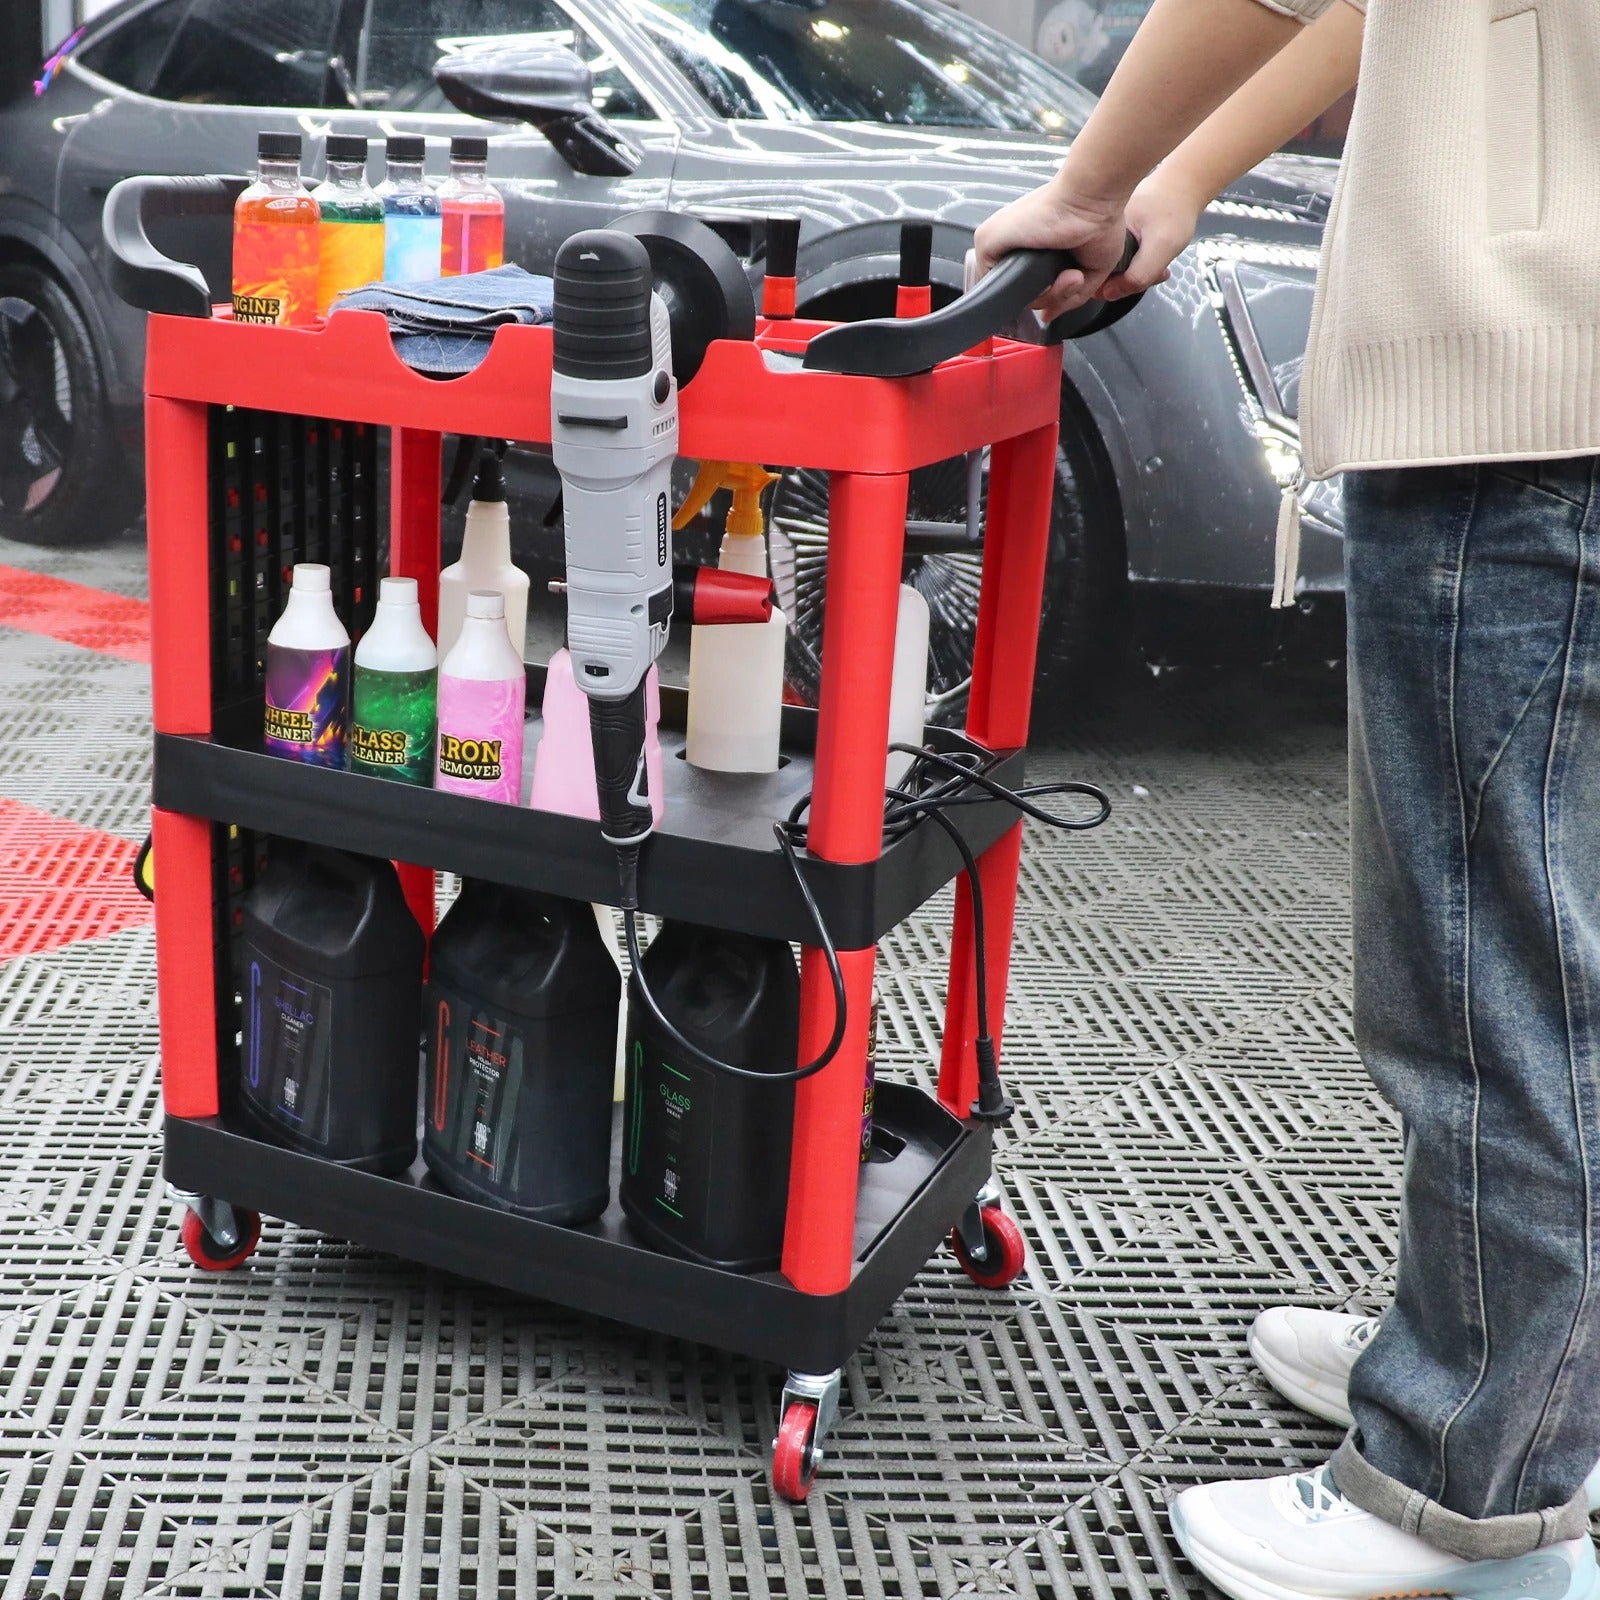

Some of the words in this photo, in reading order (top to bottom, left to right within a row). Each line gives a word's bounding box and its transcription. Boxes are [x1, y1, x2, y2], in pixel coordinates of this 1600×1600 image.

[233, 295, 279, 315] NGINE
[265, 721, 311, 741] LEANER
[352, 744, 404, 764] LEANER
[440, 734, 501, 763] IRON
[440, 758, 500, 777] REMOVER
[281, 1012, 304, 1029] CLEANER
[465, 1037, 507, 1068] LEATHER
[469, 1056, 500, 1079] PROTECTOR
[659, 1083, 691, 1111] GLASS
